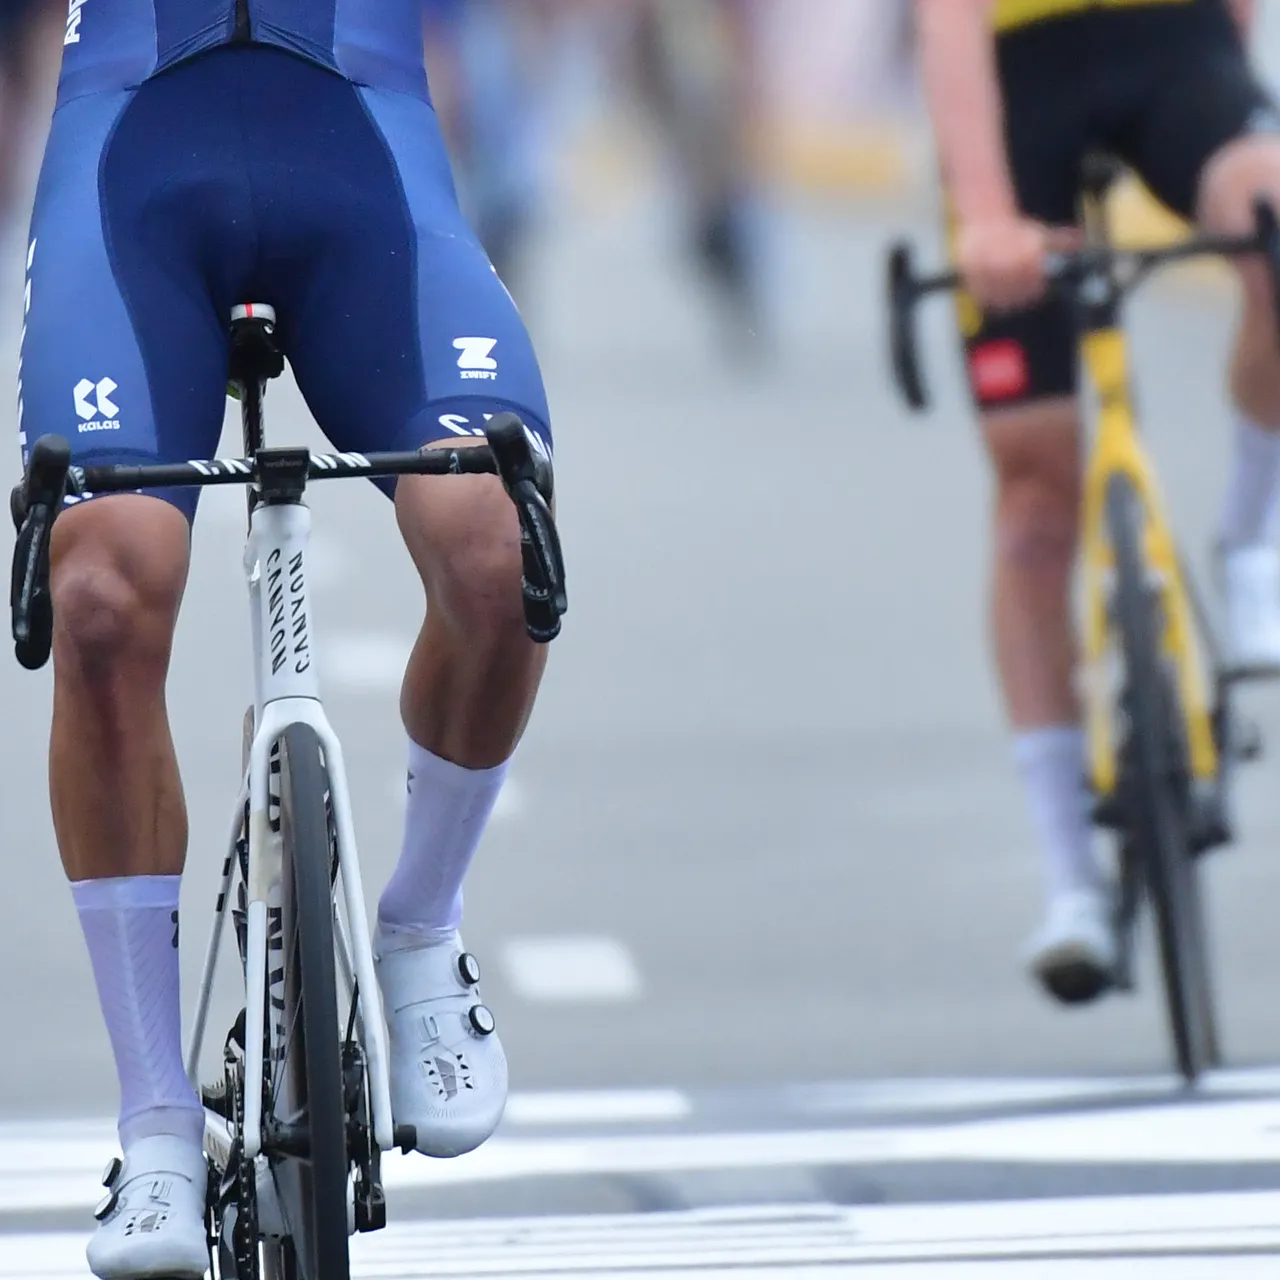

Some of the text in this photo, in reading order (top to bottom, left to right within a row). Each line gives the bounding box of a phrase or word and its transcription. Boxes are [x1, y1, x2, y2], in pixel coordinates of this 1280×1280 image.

[459, 370, 498, 381] ZWIFT
[266, 547, 287, 677] CANYON
[288, 550, 310, 674] CANYON
